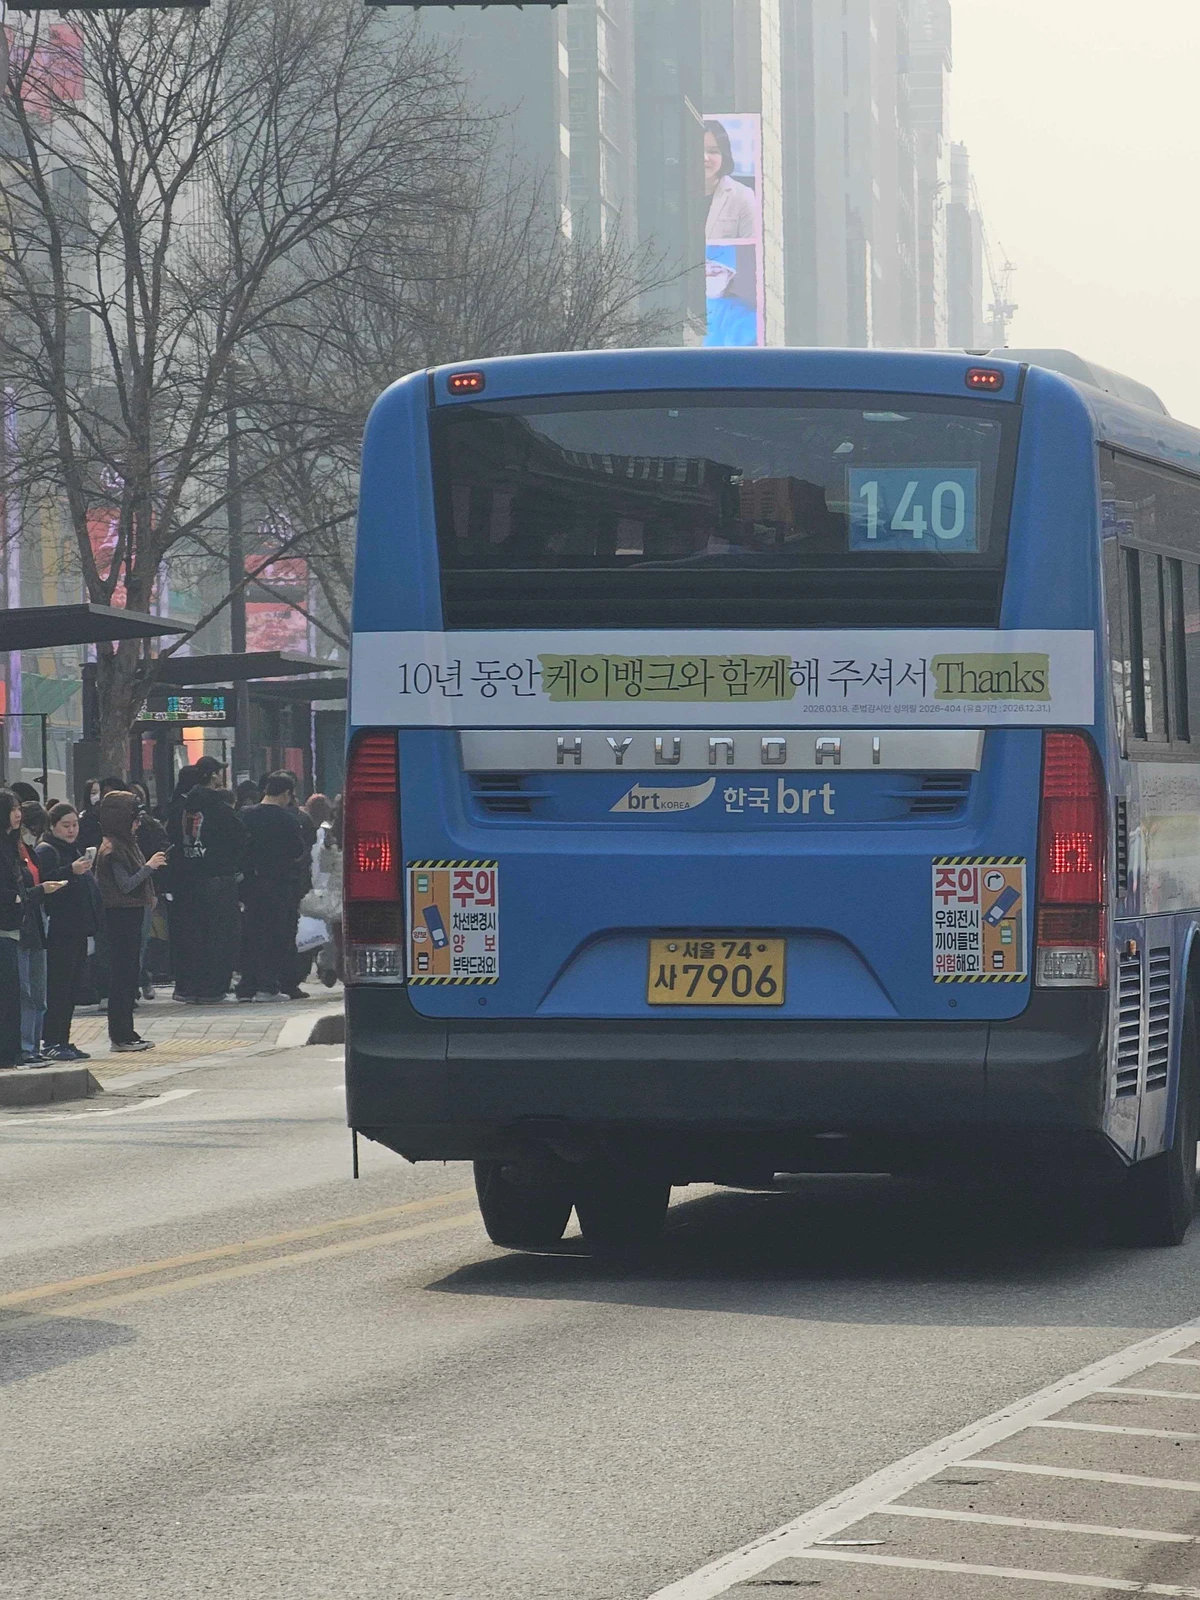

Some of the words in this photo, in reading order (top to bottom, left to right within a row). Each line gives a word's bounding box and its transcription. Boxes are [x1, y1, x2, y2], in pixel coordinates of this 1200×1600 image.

[860, 481, 965, 539] 140
[398, 659, 464, 697] 10년
[470, 659, 541, 698] 동안
[546, 658, 715, 698] 케이뱅크와
[719, 657, 819, 698] 함께해
[827, 657, 927, 698] 주셔서
[936, 660, 1046, 695] Thanks
[803, 704, 849, 713] 2026.03.18.
[919, 704, 961, 713] 2026-404
[556, 737, 881, 765] HYUNDAI
[627, 790, 660, 811] brt
[660, 801, 690, 809] KOREA
[723, 786, 770, 813] 한국
[777, 778, 836, 815] brt
[452, 870, 495, 907] 주의
[935, 867, 979, 905] 주의
[453, 912, 496, 931] 차선변경시
[935, 909, 979, 929] 우회전시
[682, 941, 715, 959] 서울
[721, 941, 752, 959] 74
[935, 932, 979, 951] 끼어들면
[453, 956, 496, 975] 부탁드려요!
[935, 953, 980, 972] 위험해요!
